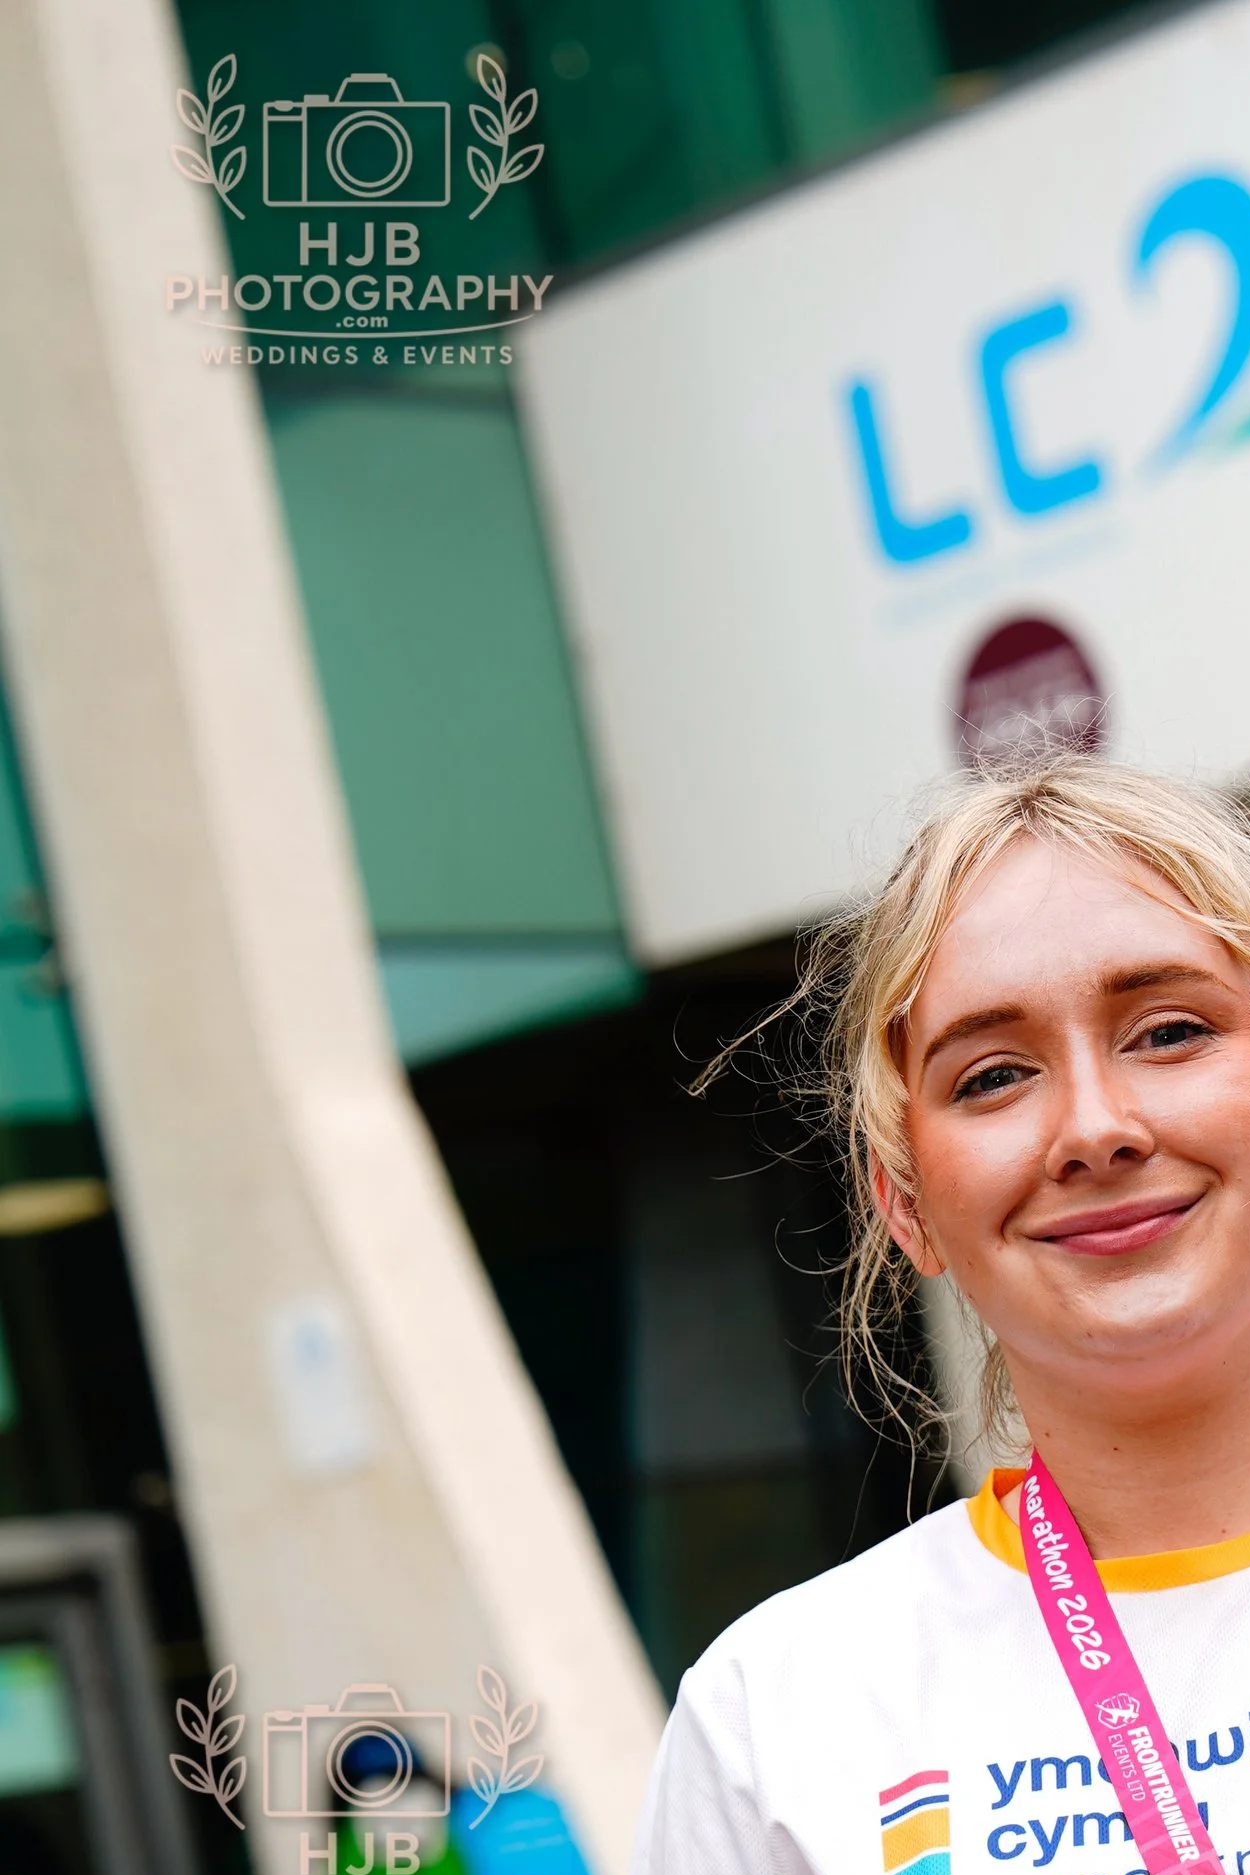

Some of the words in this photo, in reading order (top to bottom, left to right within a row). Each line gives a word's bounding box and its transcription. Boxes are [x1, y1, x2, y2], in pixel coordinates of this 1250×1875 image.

[1024, 1475, 1074, 1590] Marathon
[1057, 1594, 1111, 1671] 2026
[1108, 1734, 1138, 1780] EVENTS
[1128, 1780, 1146, 1802] LTD
[1127, 1725, 1201, 1864] FRONTRUNNER
[986, 1801, 1210, 1868] cym
